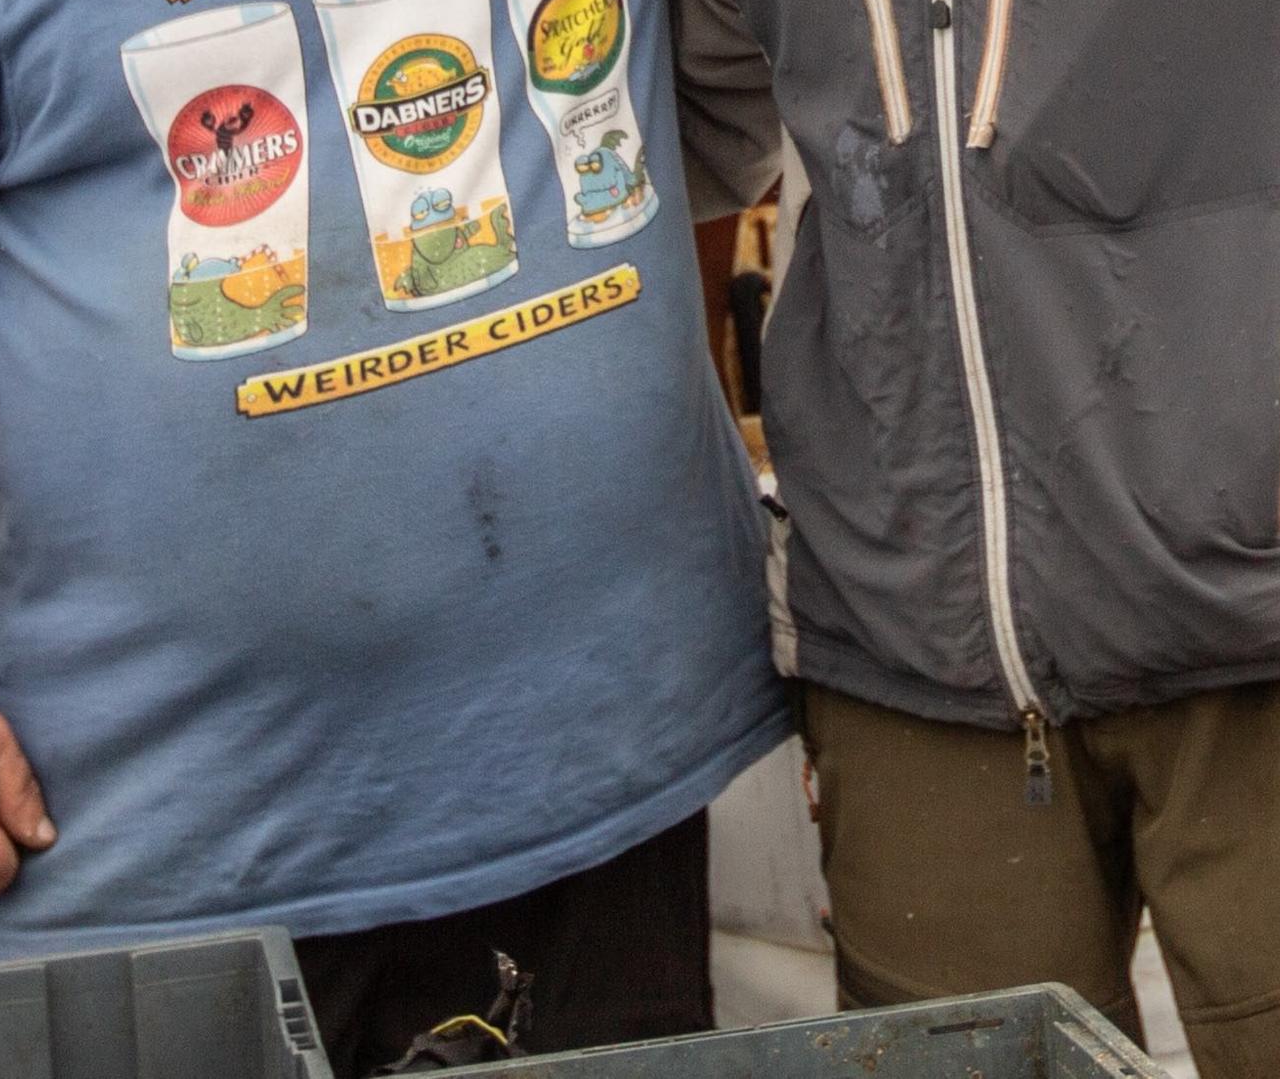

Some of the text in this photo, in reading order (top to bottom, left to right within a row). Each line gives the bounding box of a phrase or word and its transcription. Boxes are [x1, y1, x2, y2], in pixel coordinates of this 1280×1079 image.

[357, 74, 486, 132] DABNERS
[263, 275, 623, 405] WEIRDER CIDERS
